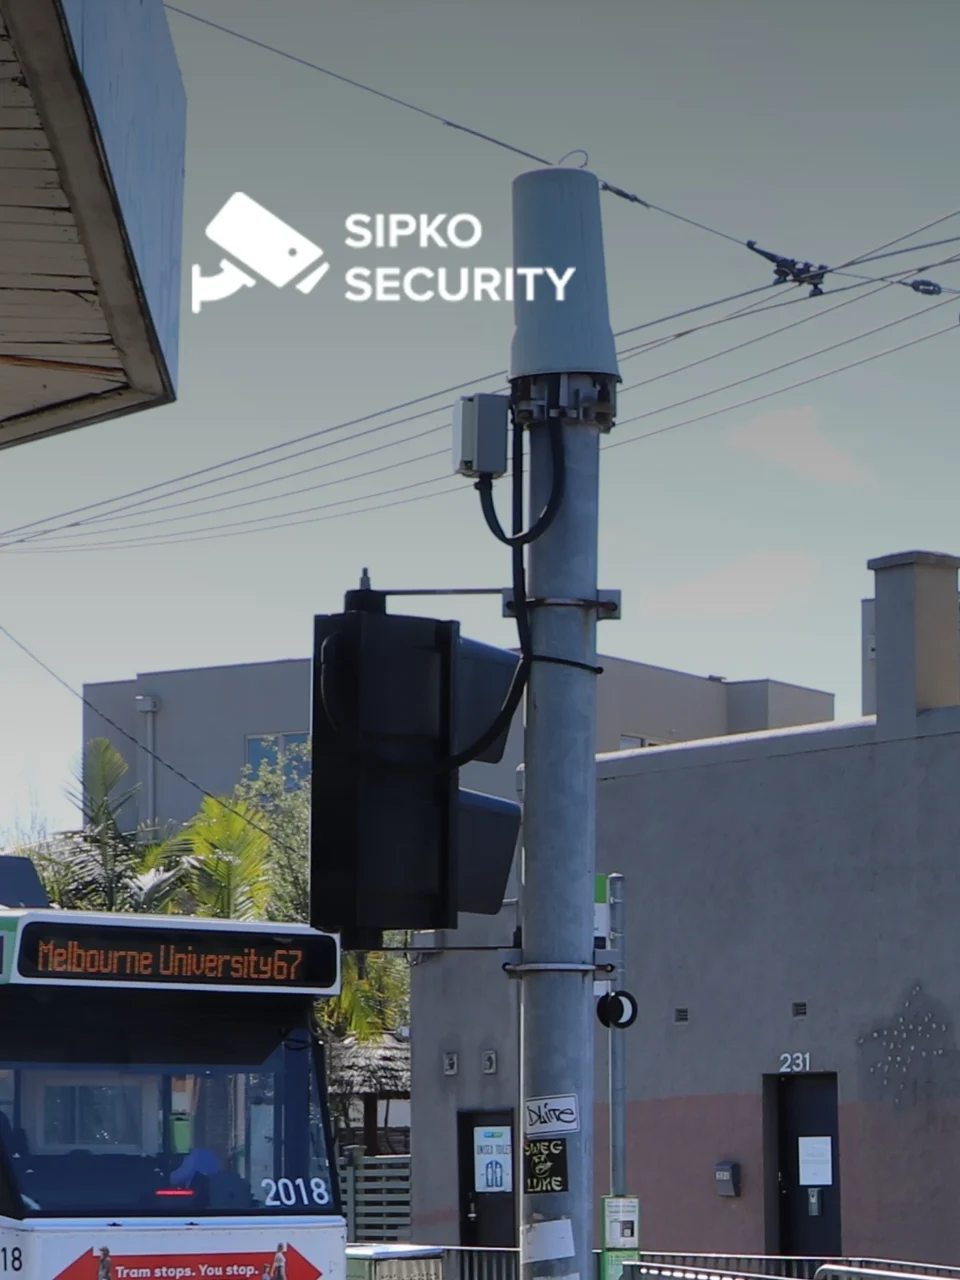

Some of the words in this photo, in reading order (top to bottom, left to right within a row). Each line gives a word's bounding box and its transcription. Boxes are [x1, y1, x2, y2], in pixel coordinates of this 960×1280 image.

[38, 939, 153, 975] Melbourne
[779, 1052, 810, 1072] 231
[261, 1177, 329, 1206] 2018
[1, 1246, 23, 1272] 18
[115, 1266, 150, 1278] Tram
[153, 1264, 196, 1279] stops.
[198, 1264, 222, 1276] You
[225, 1263, 259, 1277] stop.
